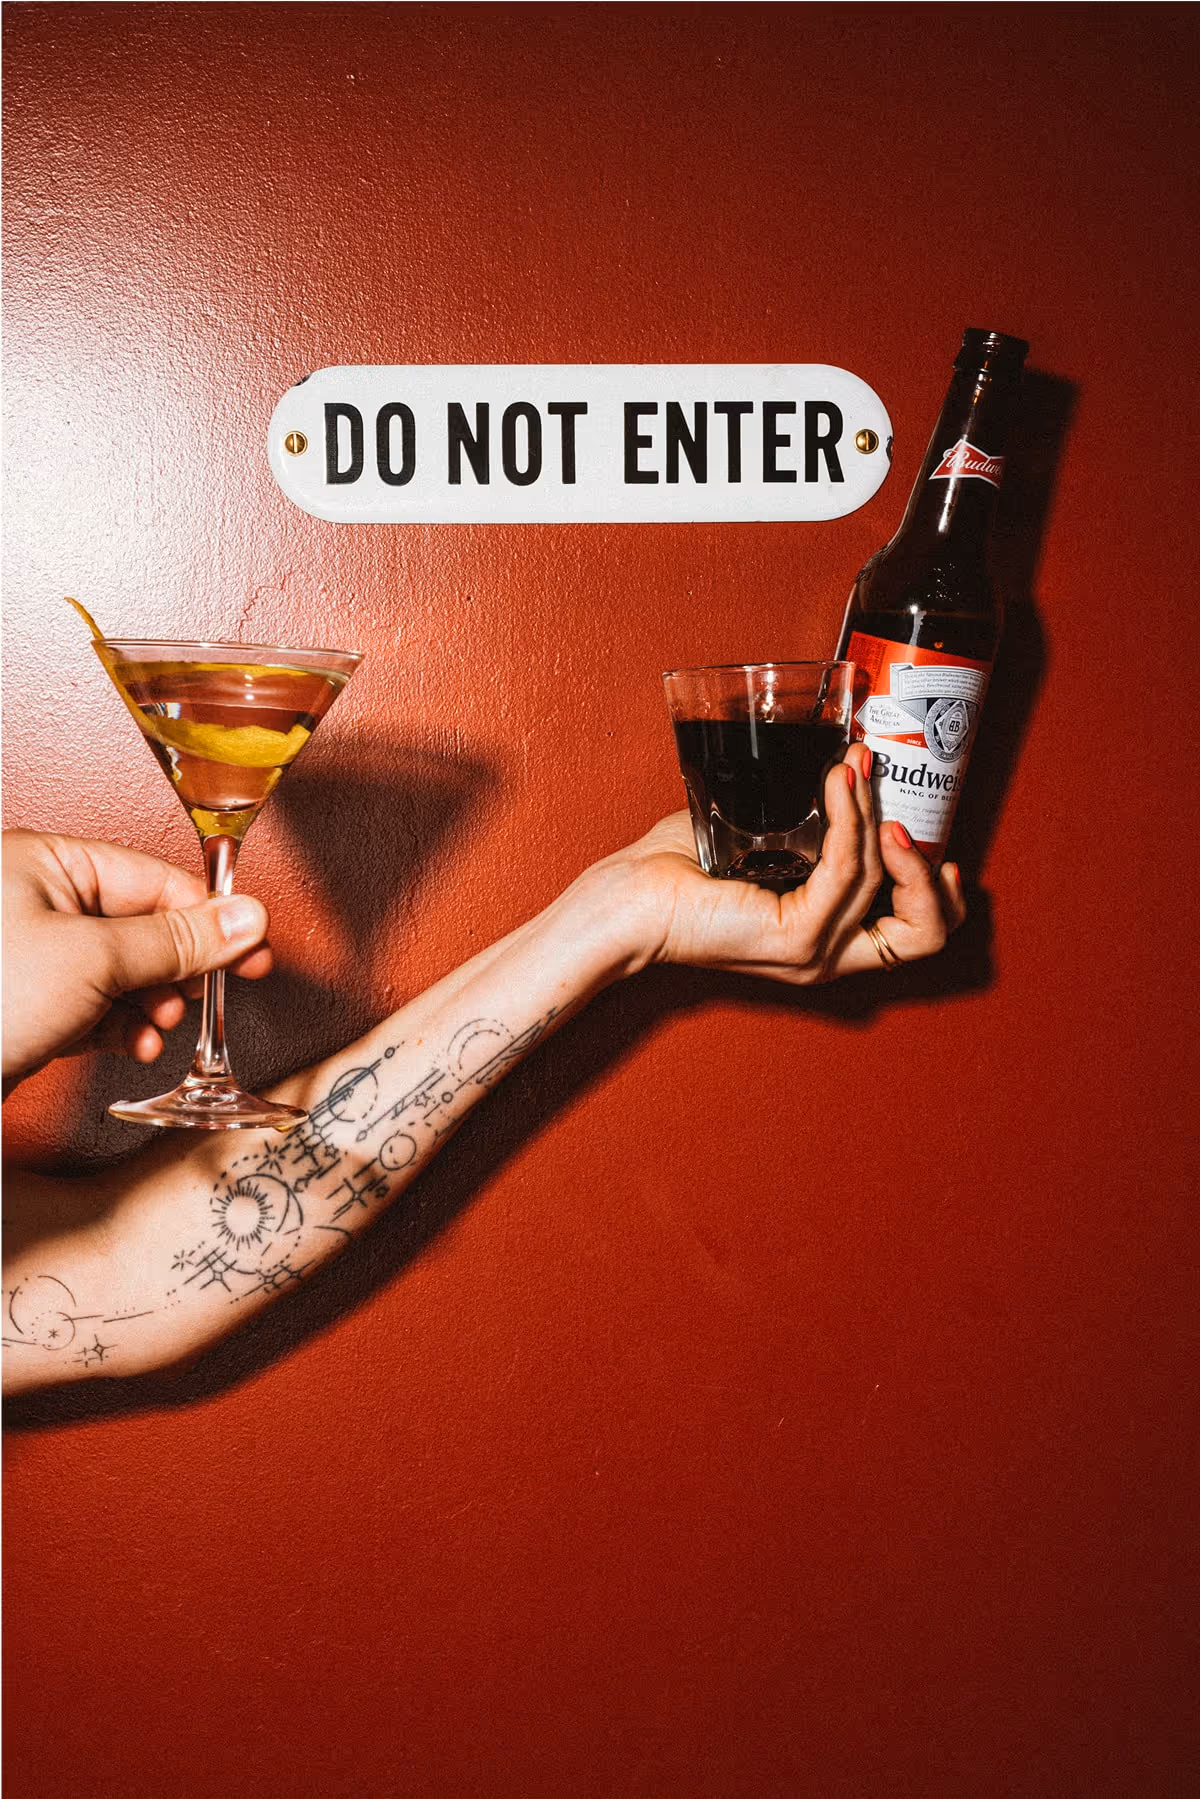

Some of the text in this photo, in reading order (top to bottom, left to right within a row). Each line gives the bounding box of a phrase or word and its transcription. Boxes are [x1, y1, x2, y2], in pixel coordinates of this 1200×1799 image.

[325, 400, 845, 487] DO NOT ENTER
[869, 706, 900, 718] THE GREAT
[869, 715, 900, 726] AMERICAN
[899, 788, 924, 798] KING
